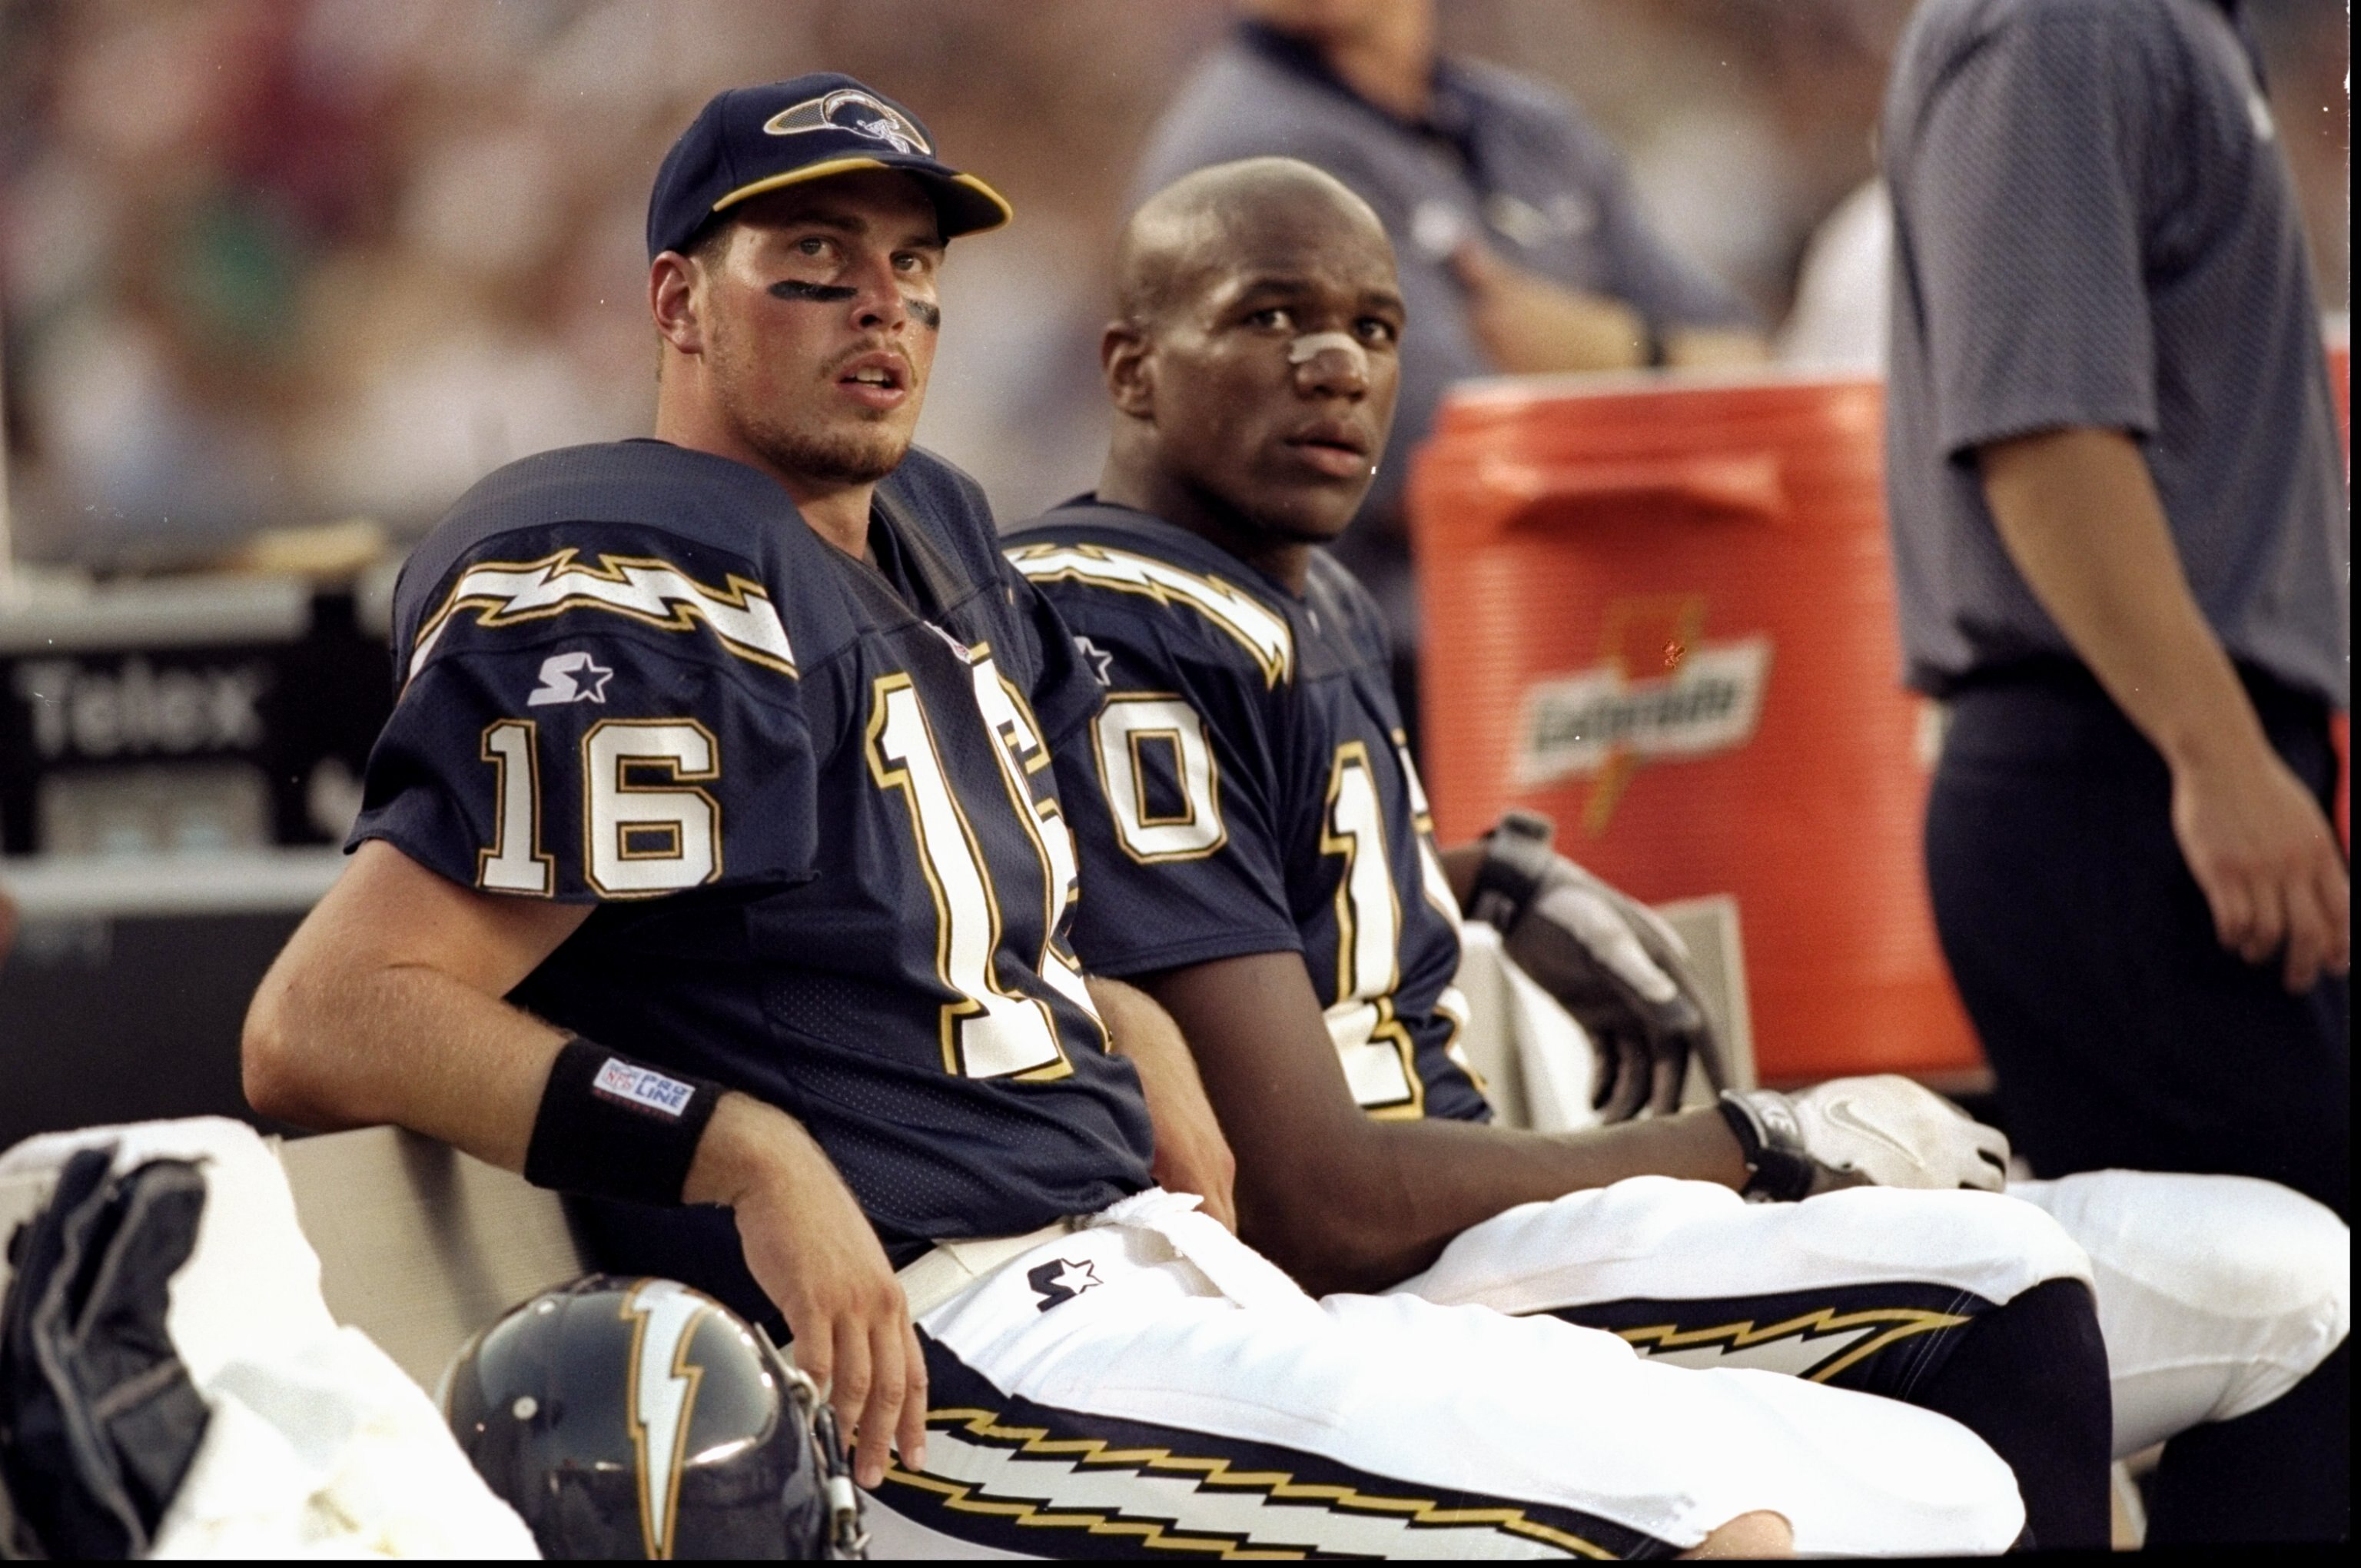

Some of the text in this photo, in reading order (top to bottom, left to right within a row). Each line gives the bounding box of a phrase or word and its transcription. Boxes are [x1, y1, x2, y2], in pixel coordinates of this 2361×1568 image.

[14, 652, 269, 761] Telex
[475, 718, 722, 899] 16
[865, 641, 1114, 1081] 16
[635, 1083, 682, 1108] LINE
[641, 1073, 688, 1096] PRO
